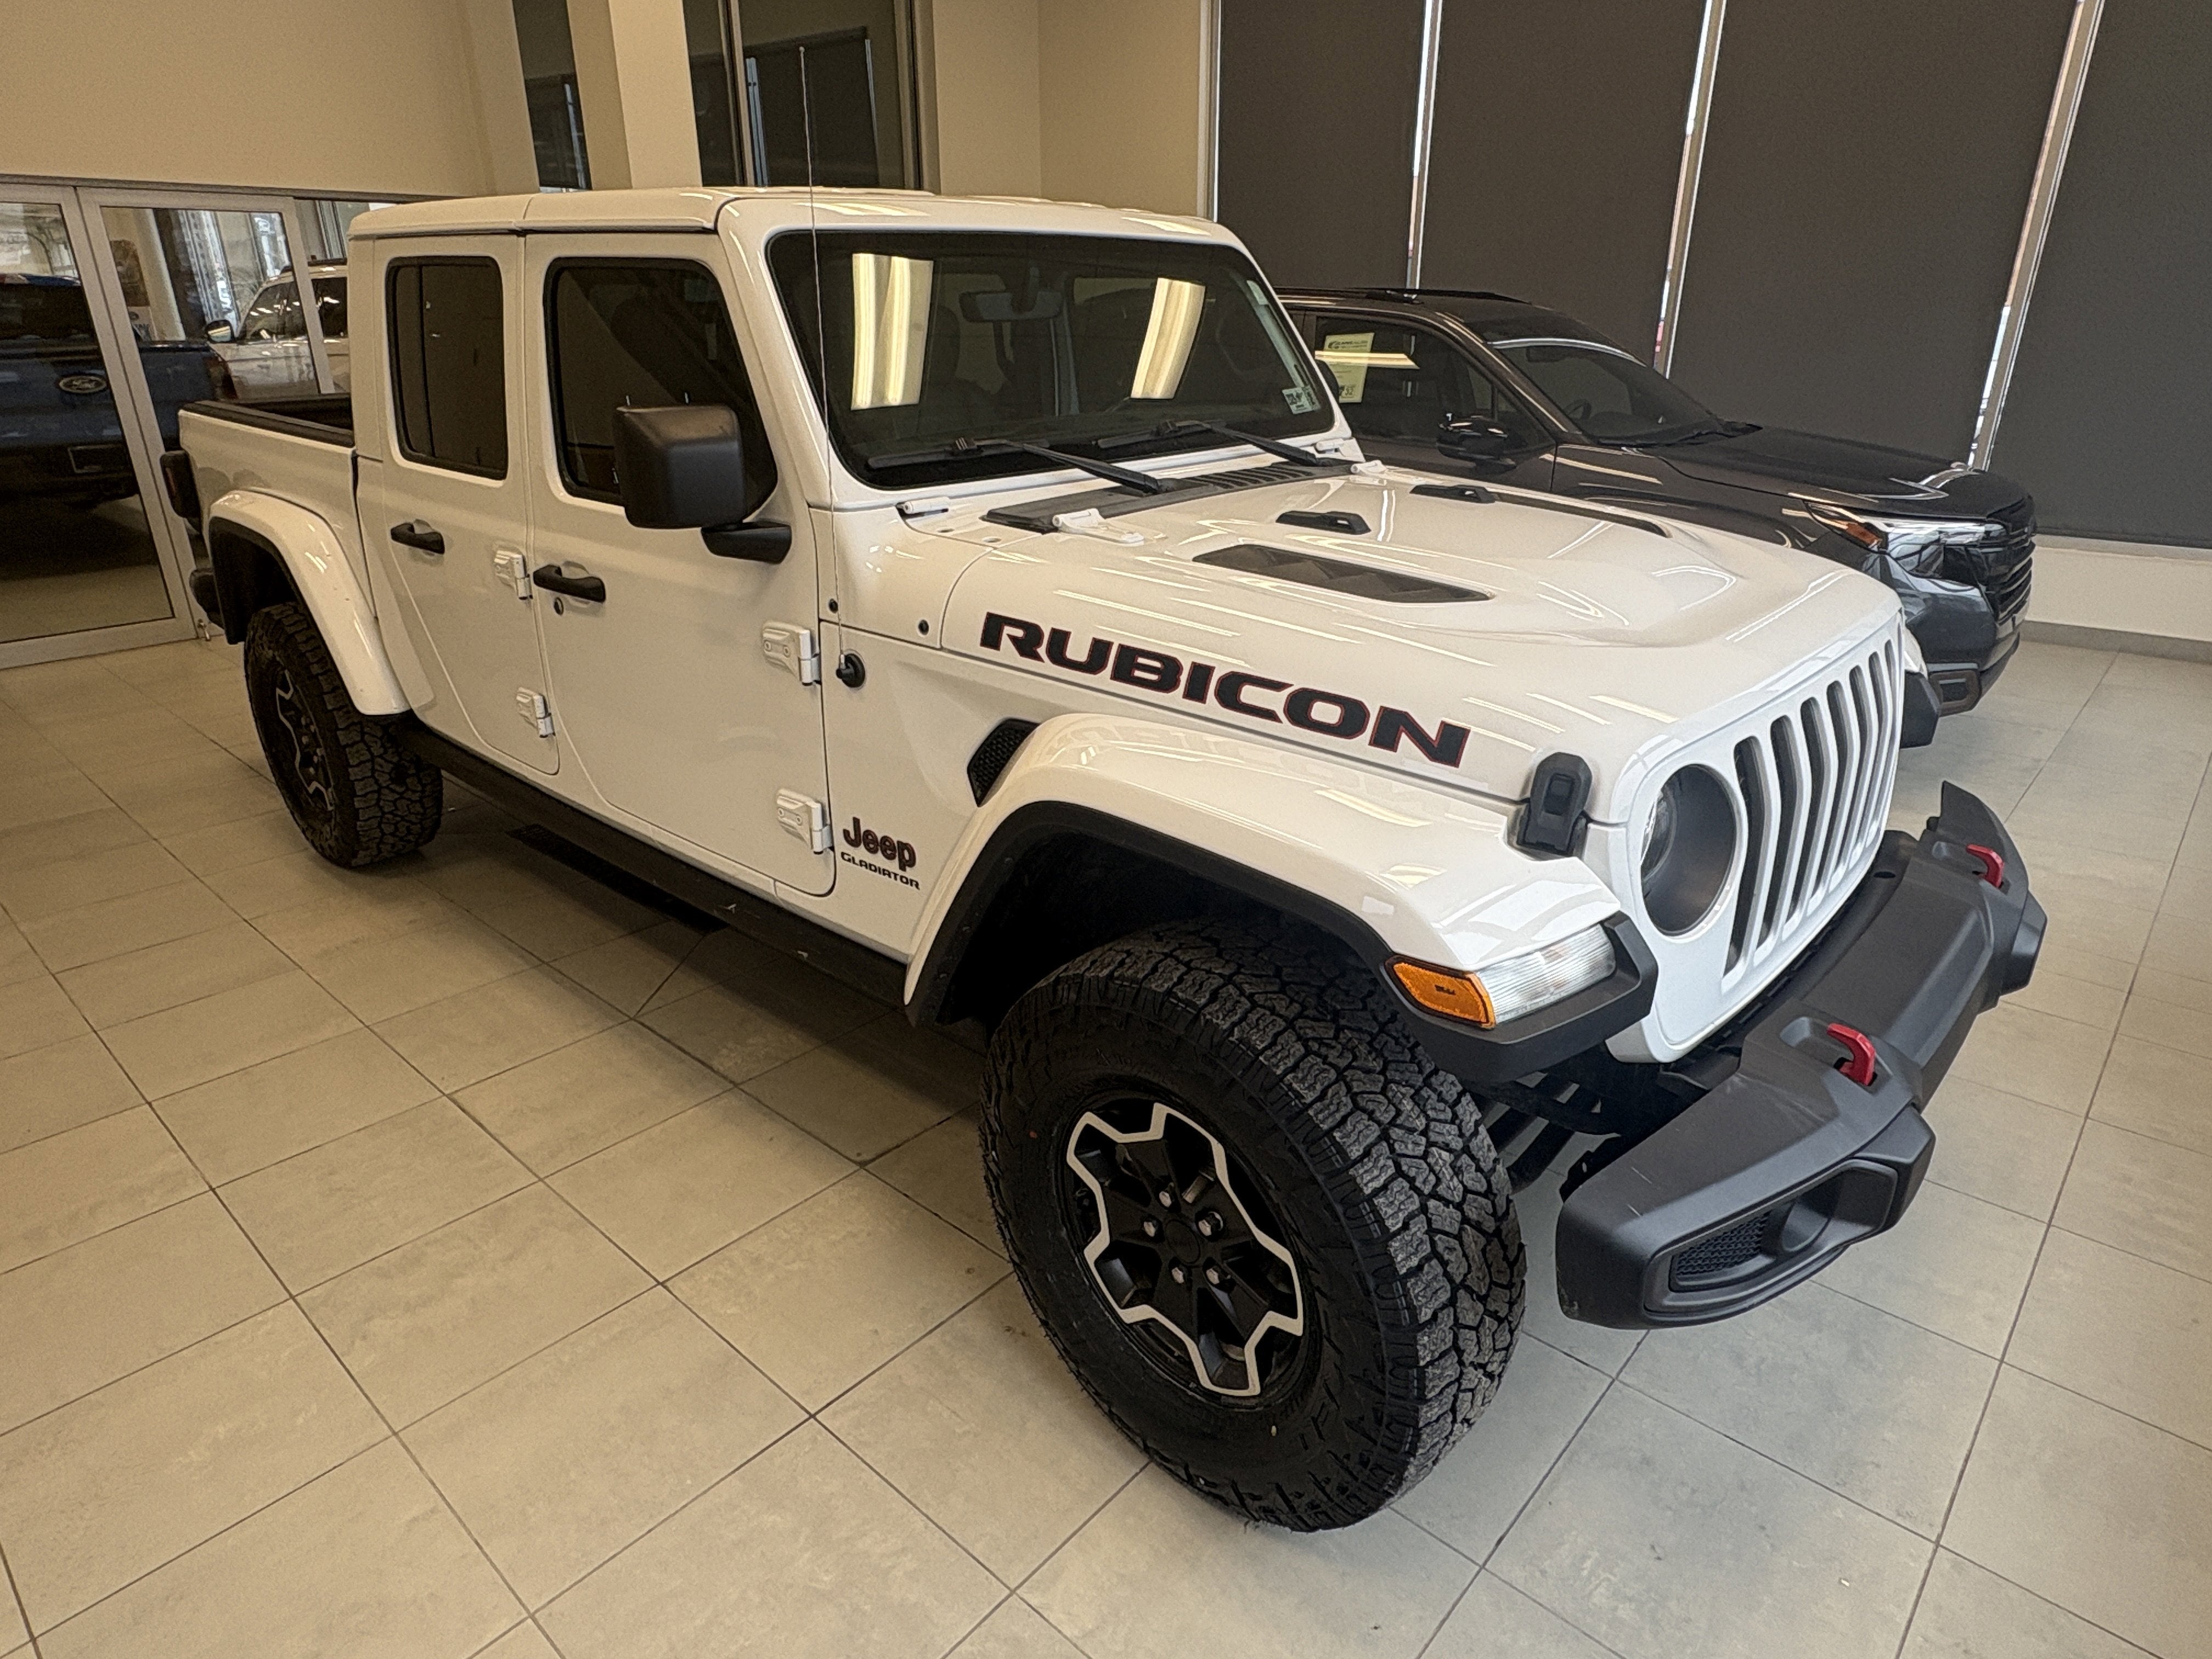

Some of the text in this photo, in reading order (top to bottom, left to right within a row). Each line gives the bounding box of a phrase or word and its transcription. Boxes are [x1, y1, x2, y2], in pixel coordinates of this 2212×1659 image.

[980, 611, 1471, 768] RUBICON
[840, 851, 921, 890] GLADIATOR
[843, 816, 916, 872] Jeep
